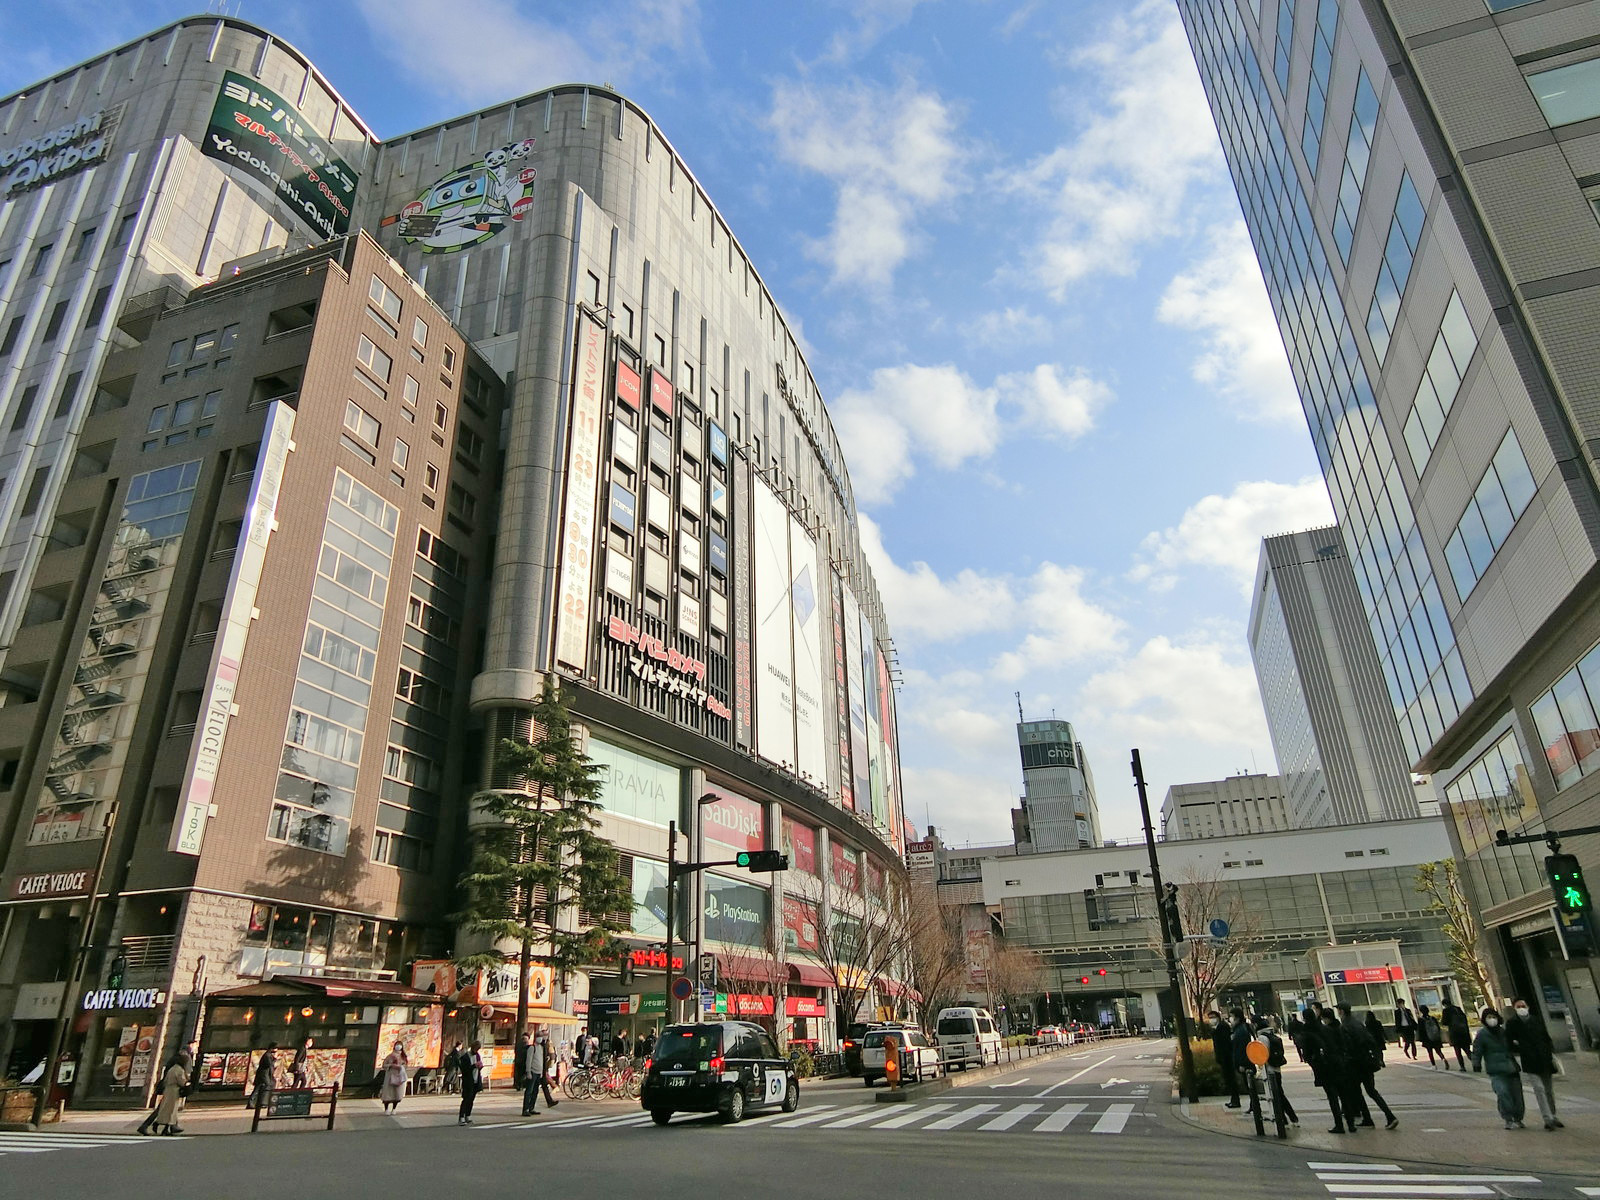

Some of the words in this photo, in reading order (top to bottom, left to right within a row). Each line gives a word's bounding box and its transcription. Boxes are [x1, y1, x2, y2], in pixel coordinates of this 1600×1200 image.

[223, 81, 355, 193] ヨドバシカメラ
[233, 111, 320, 184] マルチメディア
[317, 181, 350, 218] Akiba
[608, 614, 706, 682] ヨドバシカメラ
[629, 655, 708, 708] マルチメディア
[706, 694, 732, 721] Akiba
[767, 662, 790, 688] HUAWEI
[202, 699, 230, 757] VELOCE
[601, 765, 666, 803] BRAVIA
[704, 803, 760, 839] SanDisk
[50, 871, 87, 892] VELOCE
[723, 903, 759, 923] PlayStation
[116, 987, 160, 1008] VELOCE
[797, 1002, 815, 1012] docomo
[770, 1078, 782, 1096] GO
